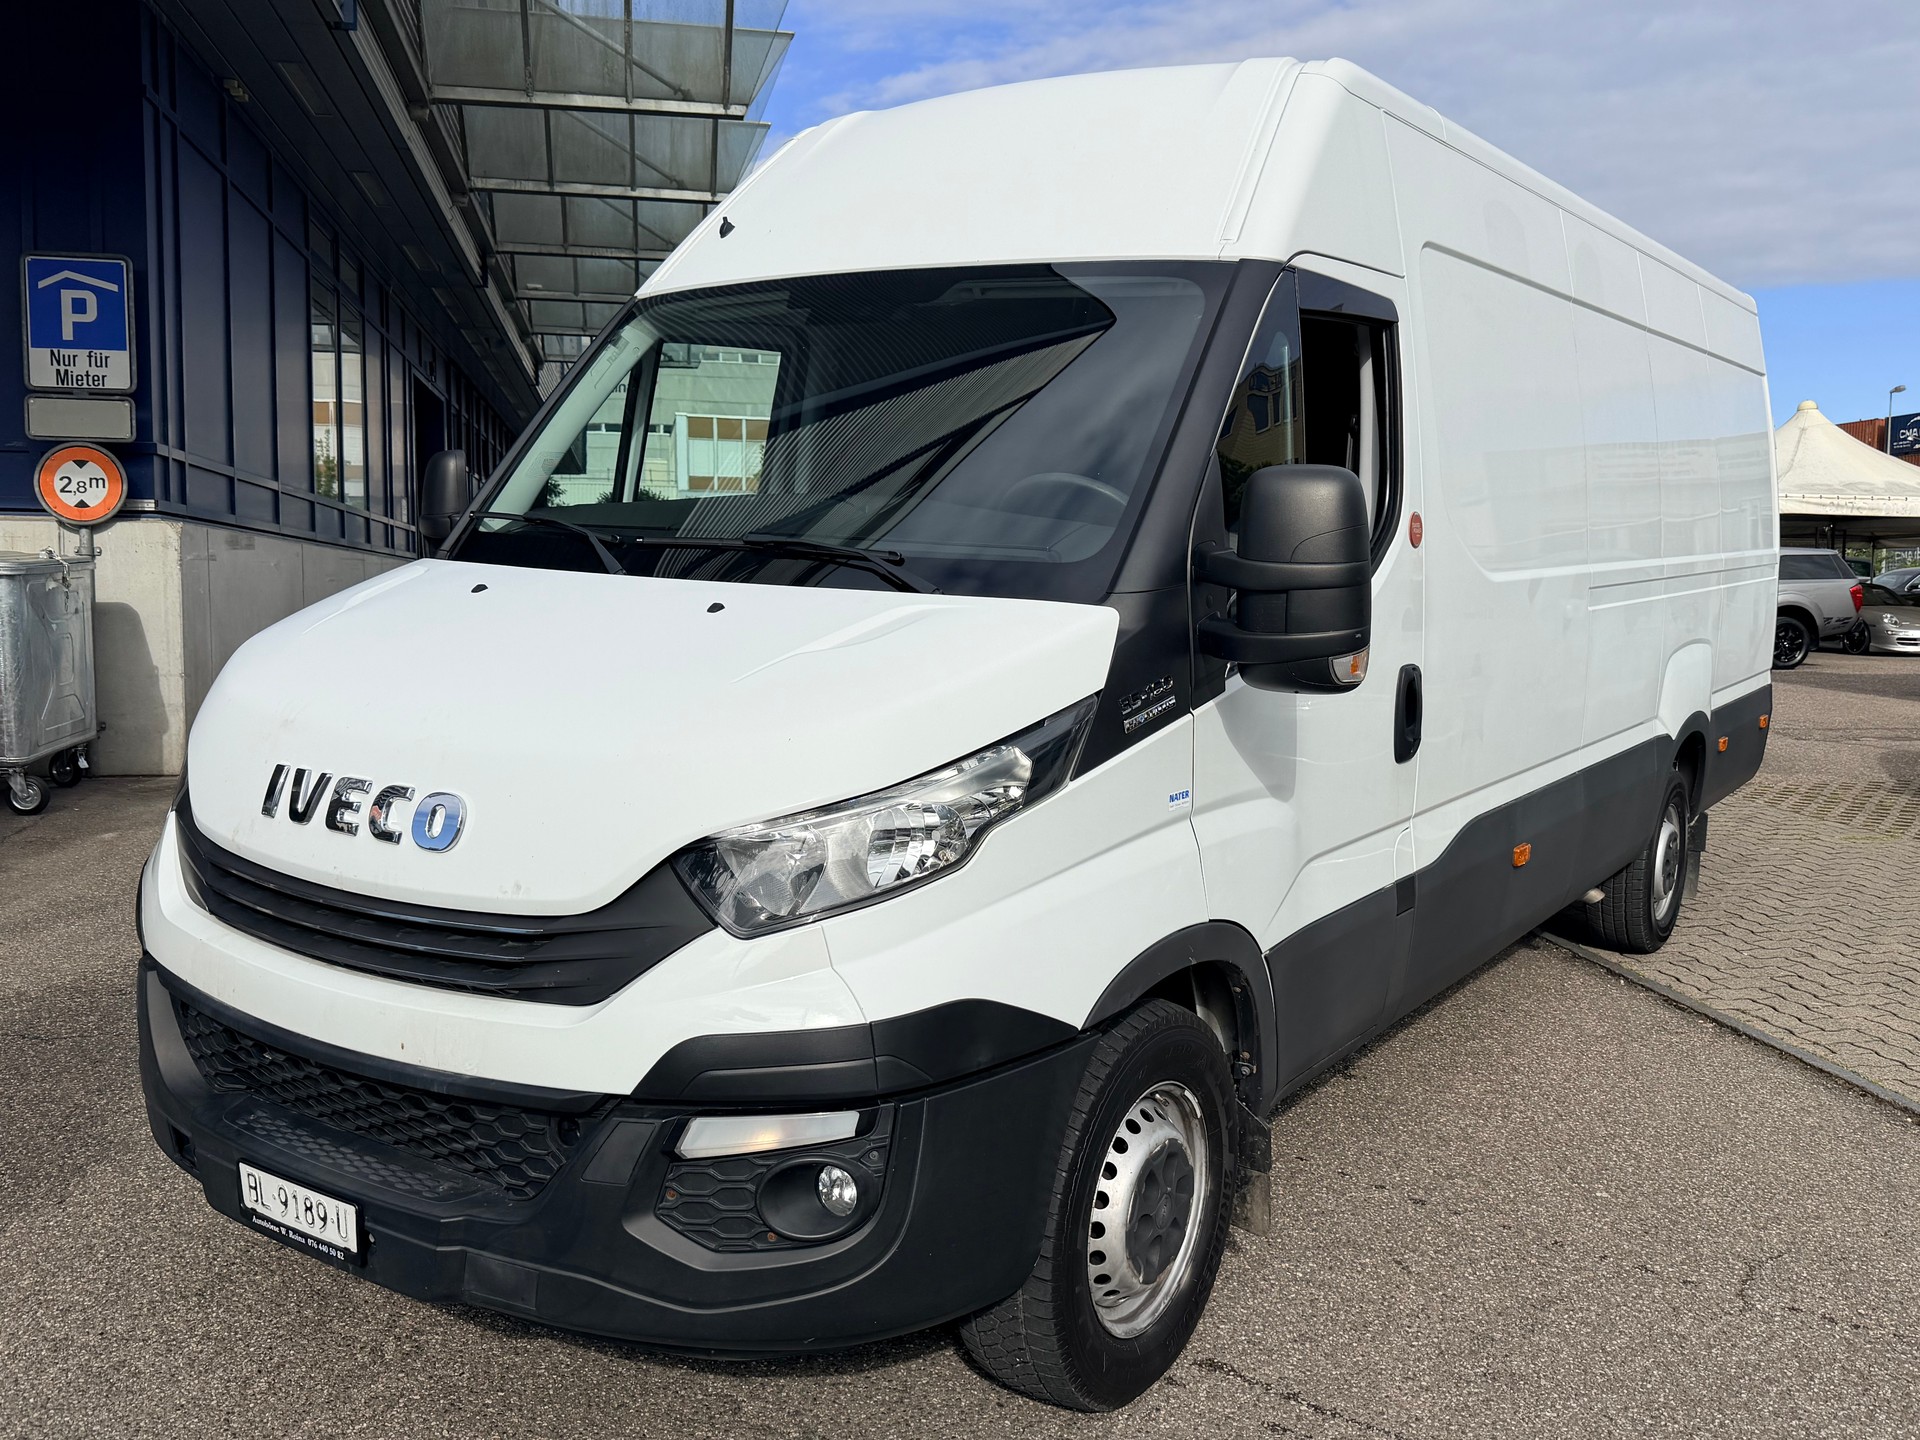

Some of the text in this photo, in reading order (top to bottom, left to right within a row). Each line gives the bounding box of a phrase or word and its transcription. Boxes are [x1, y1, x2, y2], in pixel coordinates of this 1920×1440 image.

[60, 289, 98, 341] P
[50, 349, 110, 368] Nur für
[56, 369, 107, 387] Mieter
[1899, 428, 1918, 439] CMA
[1169, 790, 1190, 803] NATER
[261, 764, 467, 853] IVECO
[307, 1239, 317, 1249] 076
[319, 1243, 328, 1253] 440
[337, 1251, 345, 1260] 82
